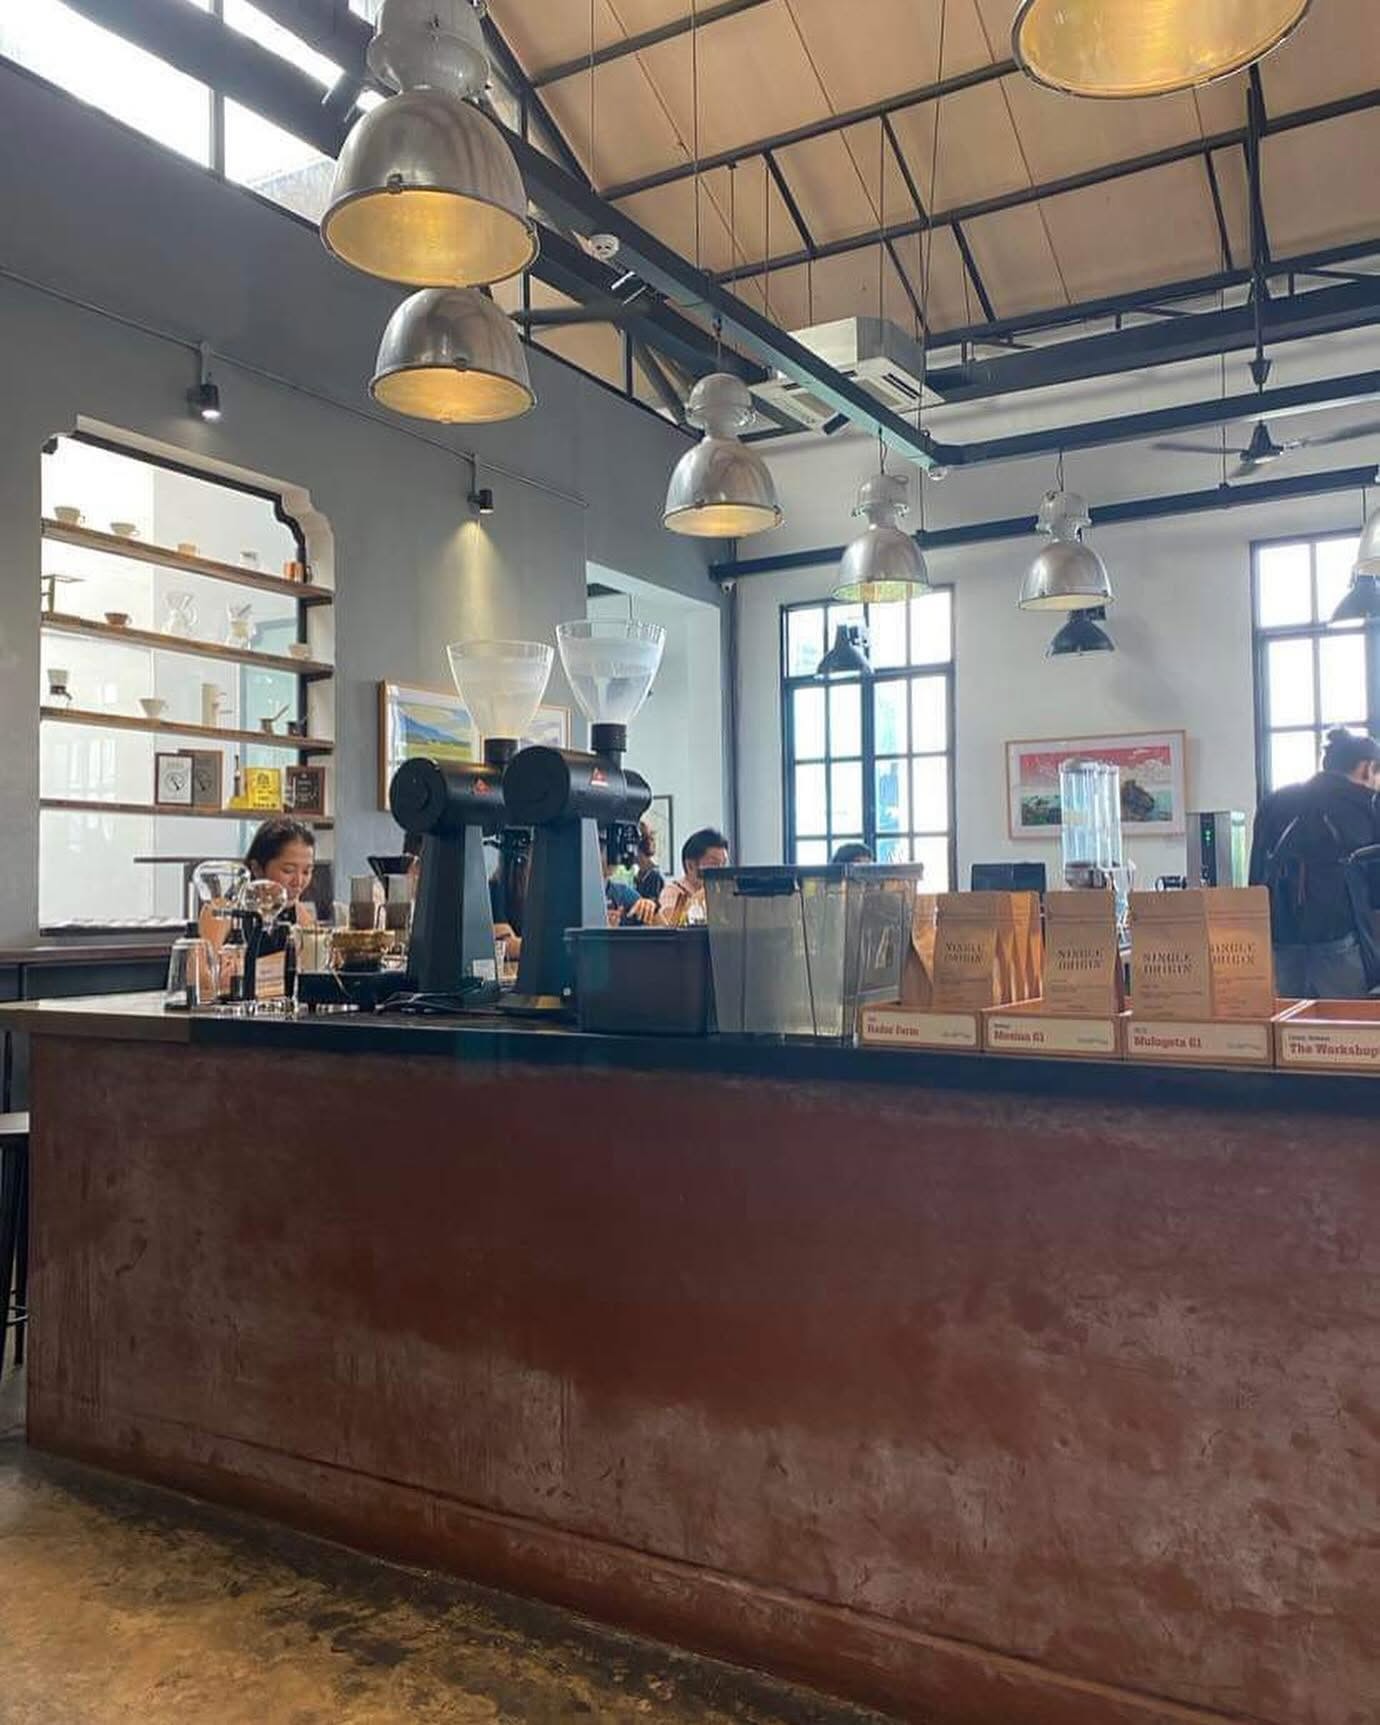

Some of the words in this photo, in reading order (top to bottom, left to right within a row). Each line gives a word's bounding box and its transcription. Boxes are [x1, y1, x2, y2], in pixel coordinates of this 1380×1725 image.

[1144, 951, 1192, 963] SINGLE
[1144, 963, 1192, 974] ORIGIN
[1289, 1042, 1312, 1054] The
[1315, 1043, 1379, 1059] Workshop
